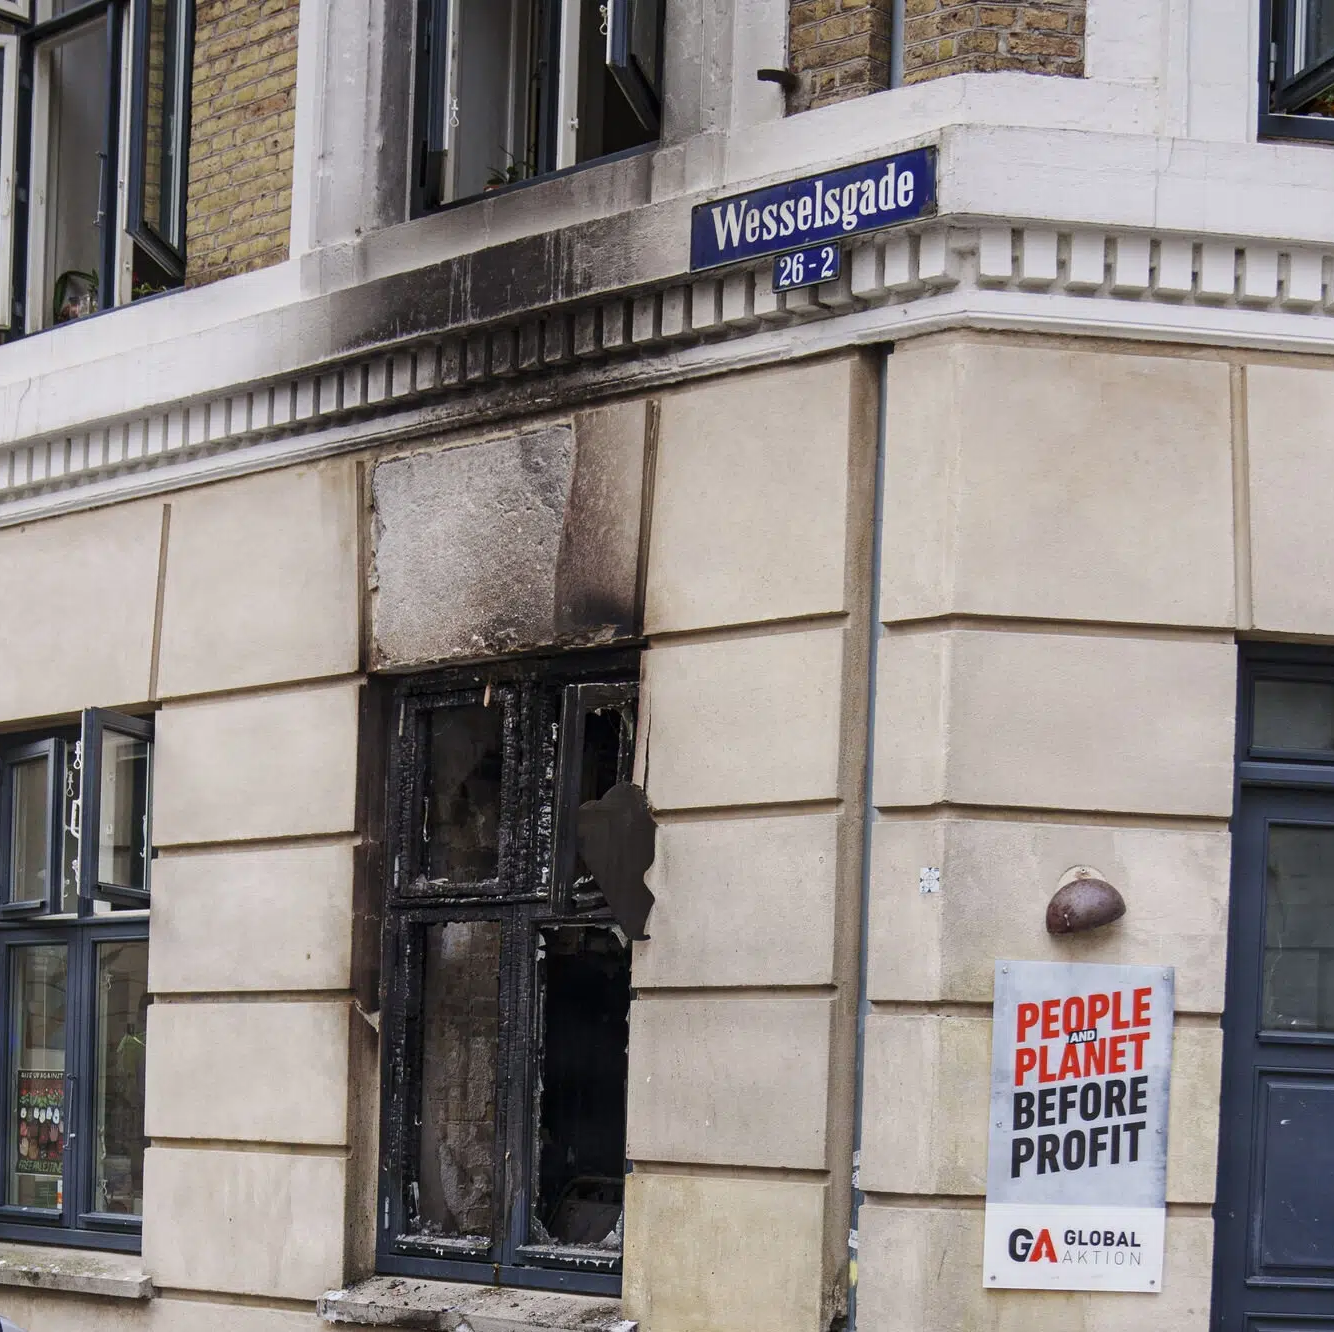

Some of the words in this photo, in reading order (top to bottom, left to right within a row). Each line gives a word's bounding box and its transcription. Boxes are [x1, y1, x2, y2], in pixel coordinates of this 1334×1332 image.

[711, 162, 915, 251] Wesselsgade
[779, 253, 804, 286] 26
[1017, 987, 1152, 1043] PEOPLE
[1070, 1030, 1096, 1044] AND
[1014, 1032, 1151, 1086] PLANET
[1013, 1076, 1148, 1131] BEFORE
[1011, 1121, 1147, 1178] PROFIT
[1009, 1228, 1057, 1263] GA
[1062, 1250, 1141, 1265] AKTION
[1064, 1229, 1141, 1247] GLOBAL
